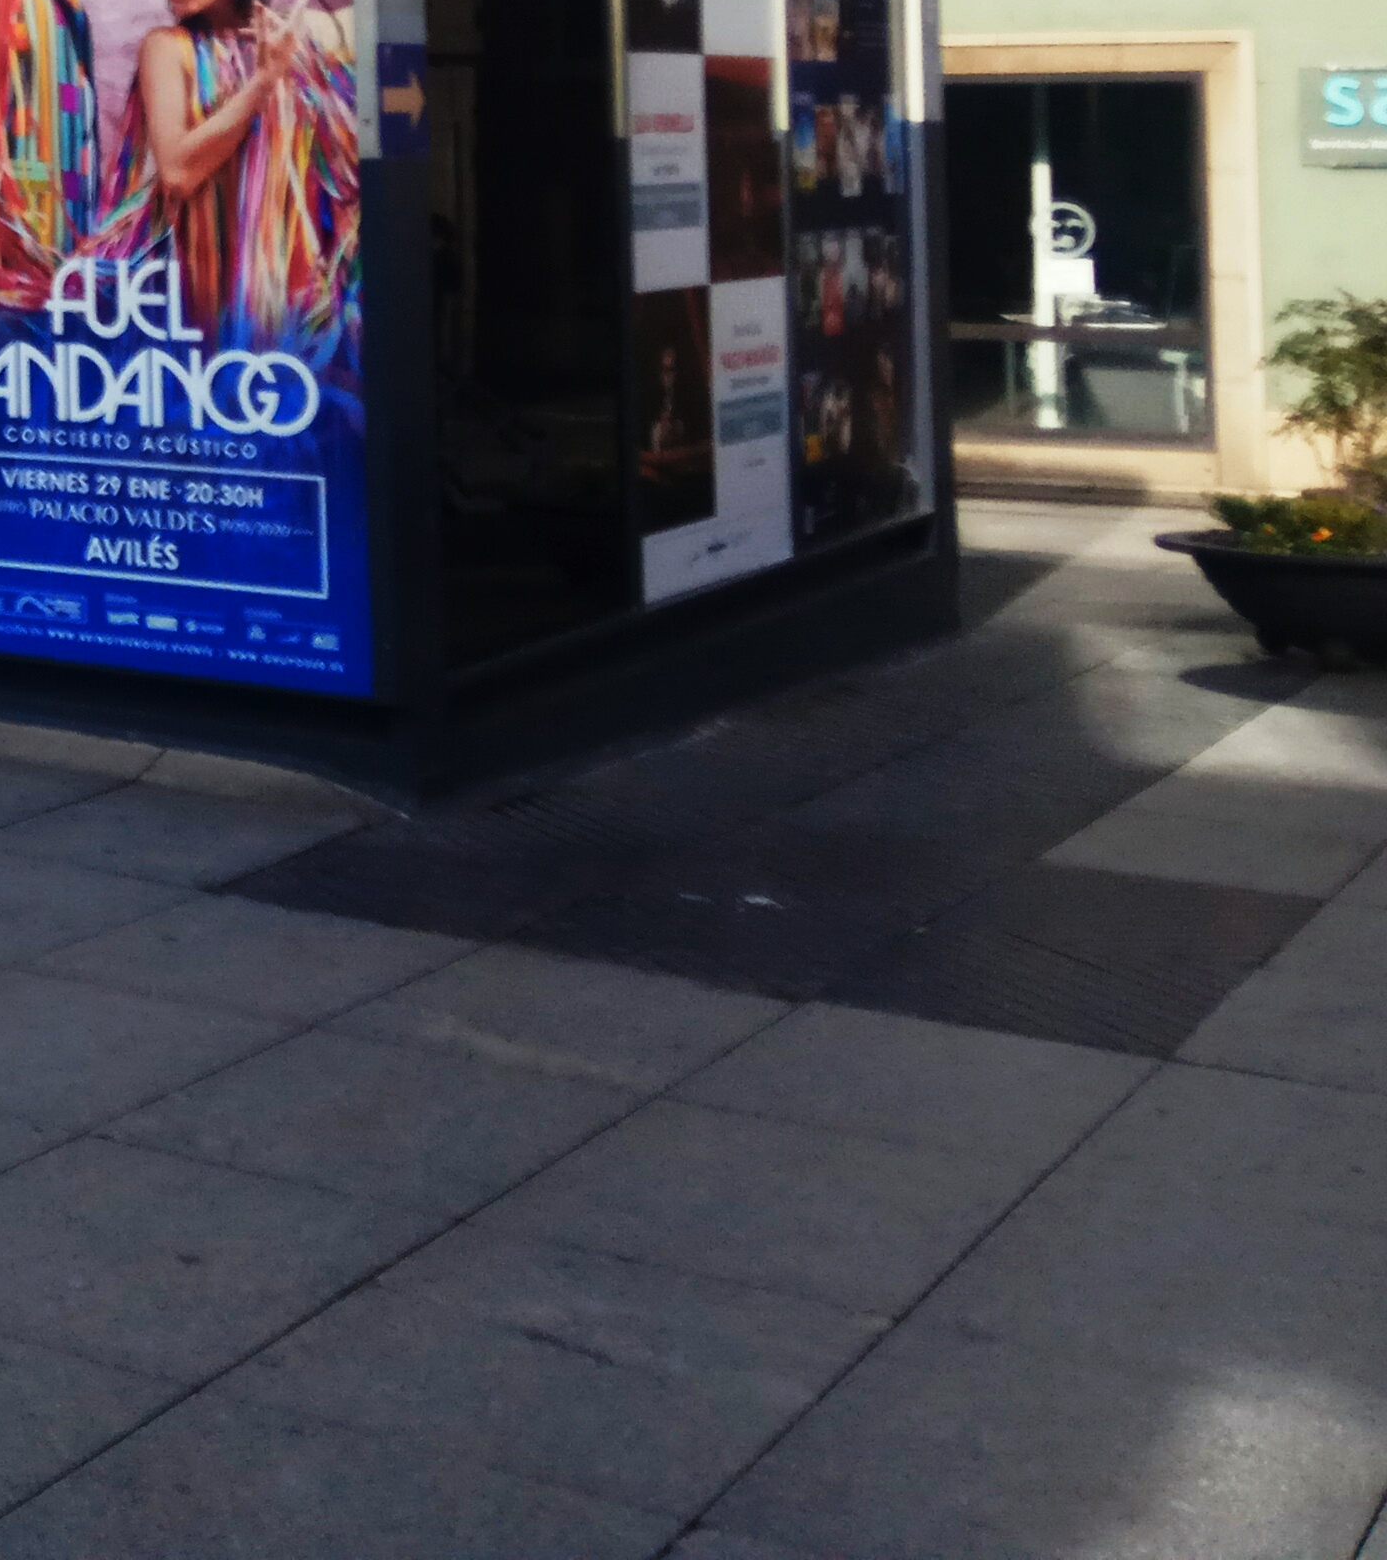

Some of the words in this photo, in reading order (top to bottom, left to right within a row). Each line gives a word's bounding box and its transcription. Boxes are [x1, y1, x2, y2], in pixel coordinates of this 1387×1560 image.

[44, 257, 204, 342] FUEL
[3, 425, 131, 452] CONCIERTO
[141, 432, 258, 460] ACÚSTICO
[0, 466, 90, 496] VIERNES
[96, 473, 122, 496] 29
[29, 498, 120, 527] PALACIO
[85, 534, 179, 570] AVILÉS
